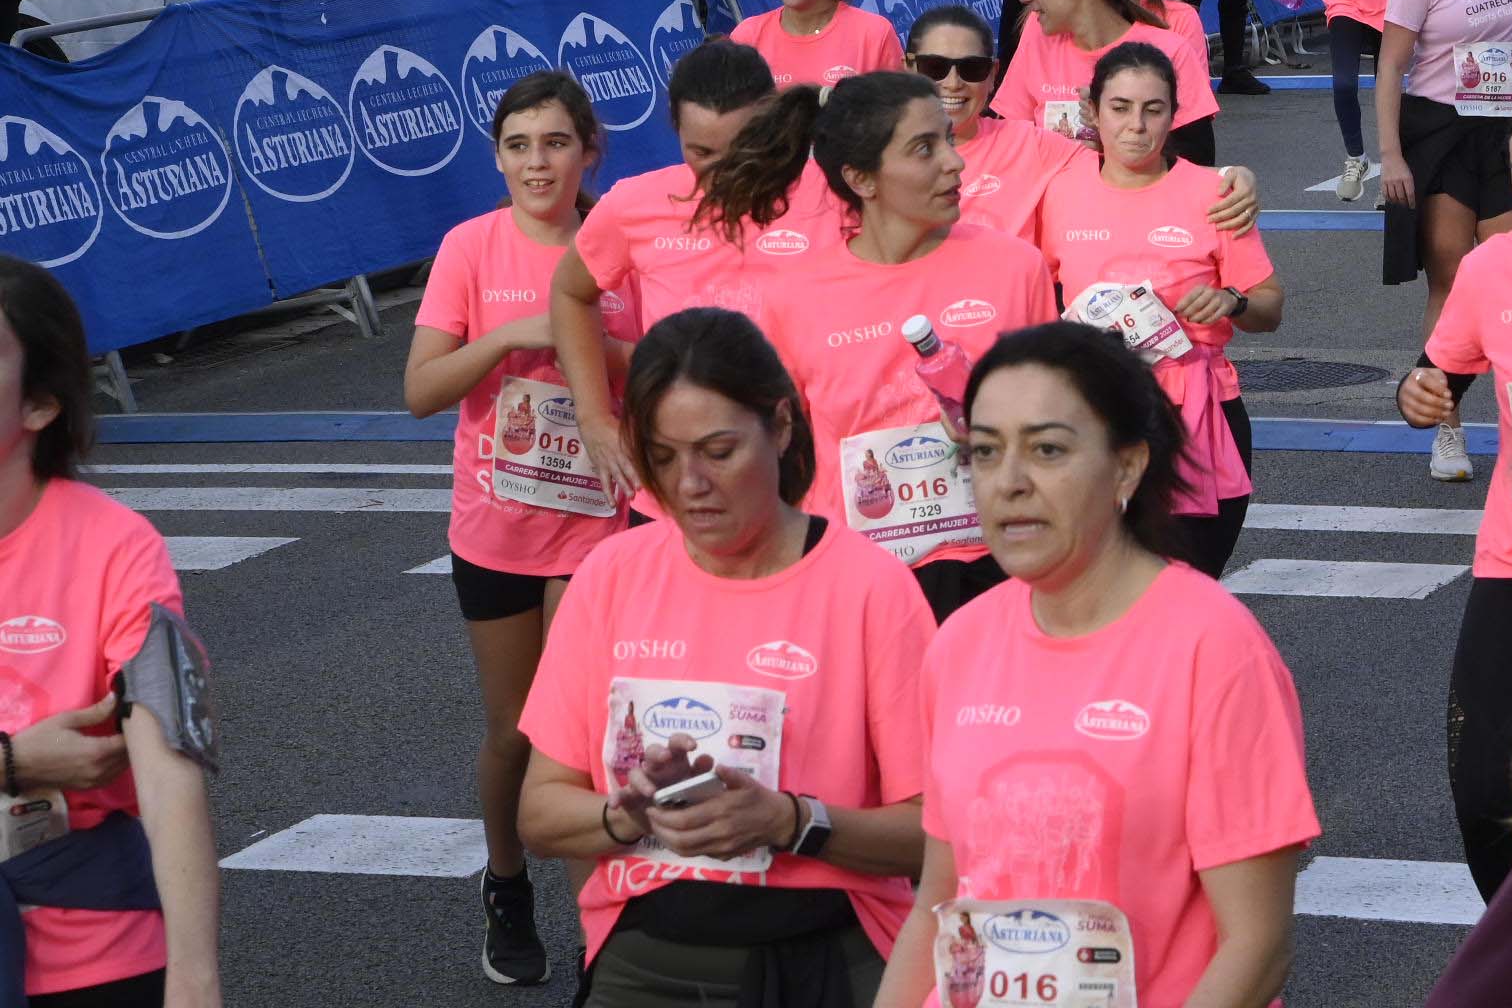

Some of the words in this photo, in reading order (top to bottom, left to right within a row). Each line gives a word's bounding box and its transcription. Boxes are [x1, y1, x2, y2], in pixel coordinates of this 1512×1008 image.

[1482, 72, 1506, 83] 016
[370, 92, 405, 108] CENTRAL
[407, 82, 443, 99] LECHERA
[359, 100, 459, 150] ASTURIANA
[124, 144, 168, 164] CENTRAL
[245, 122, 349, 175] ASTURIANA
[0, 168, 36, 186] NTRAL
[112, 151, 226, 211] ASTURIANA
[0, 182, 96, 235] STURIANA
[654, 236, 711, 252] OYSHO
[1066, 229, 1110, 241] OYSHO
[482, 289, 536, 303] OYSHO
[828, 321, 892, 348] OYSHO
[538, 432, 580, 456] 016
[540, 454, 572, 471] 13594
[889, 447, 945, 465] ASTURIANA
[505, 464, 538, 477] CARRERA
[539, 469, 549, 478] DE
[550, 470, 560, 480] LA
[562, 472, 588, 486] MUJER
[501, 479, 536, 496] OYSHO
[898, 477, 948, 502] 016
[568, 492, 607, 507] Santander
[910, 504, 942, 519] 7329
[869, 527, 912, 541] CARRERA
[913, 524, 925, 533] DE
[926, 522, 938, 532] LA
[939, 517, 968, 530] MUJER
[614, 640, 686, 660] OYSHO
[754, 651, 810, 673] ASTURIANA
[651, 714, 716, 732] ASTURIANA
[730, 710, 767, 723] SUMA
[957, 705, 1021, 727] OYSHO
[1083, 713, 1144, 733] ASTURIANA
[990, 925, 1064, 944] ASTURIANA
[1076, 920, 1117, 933] SUMA
[990, 970, 1058, 1001] 016
